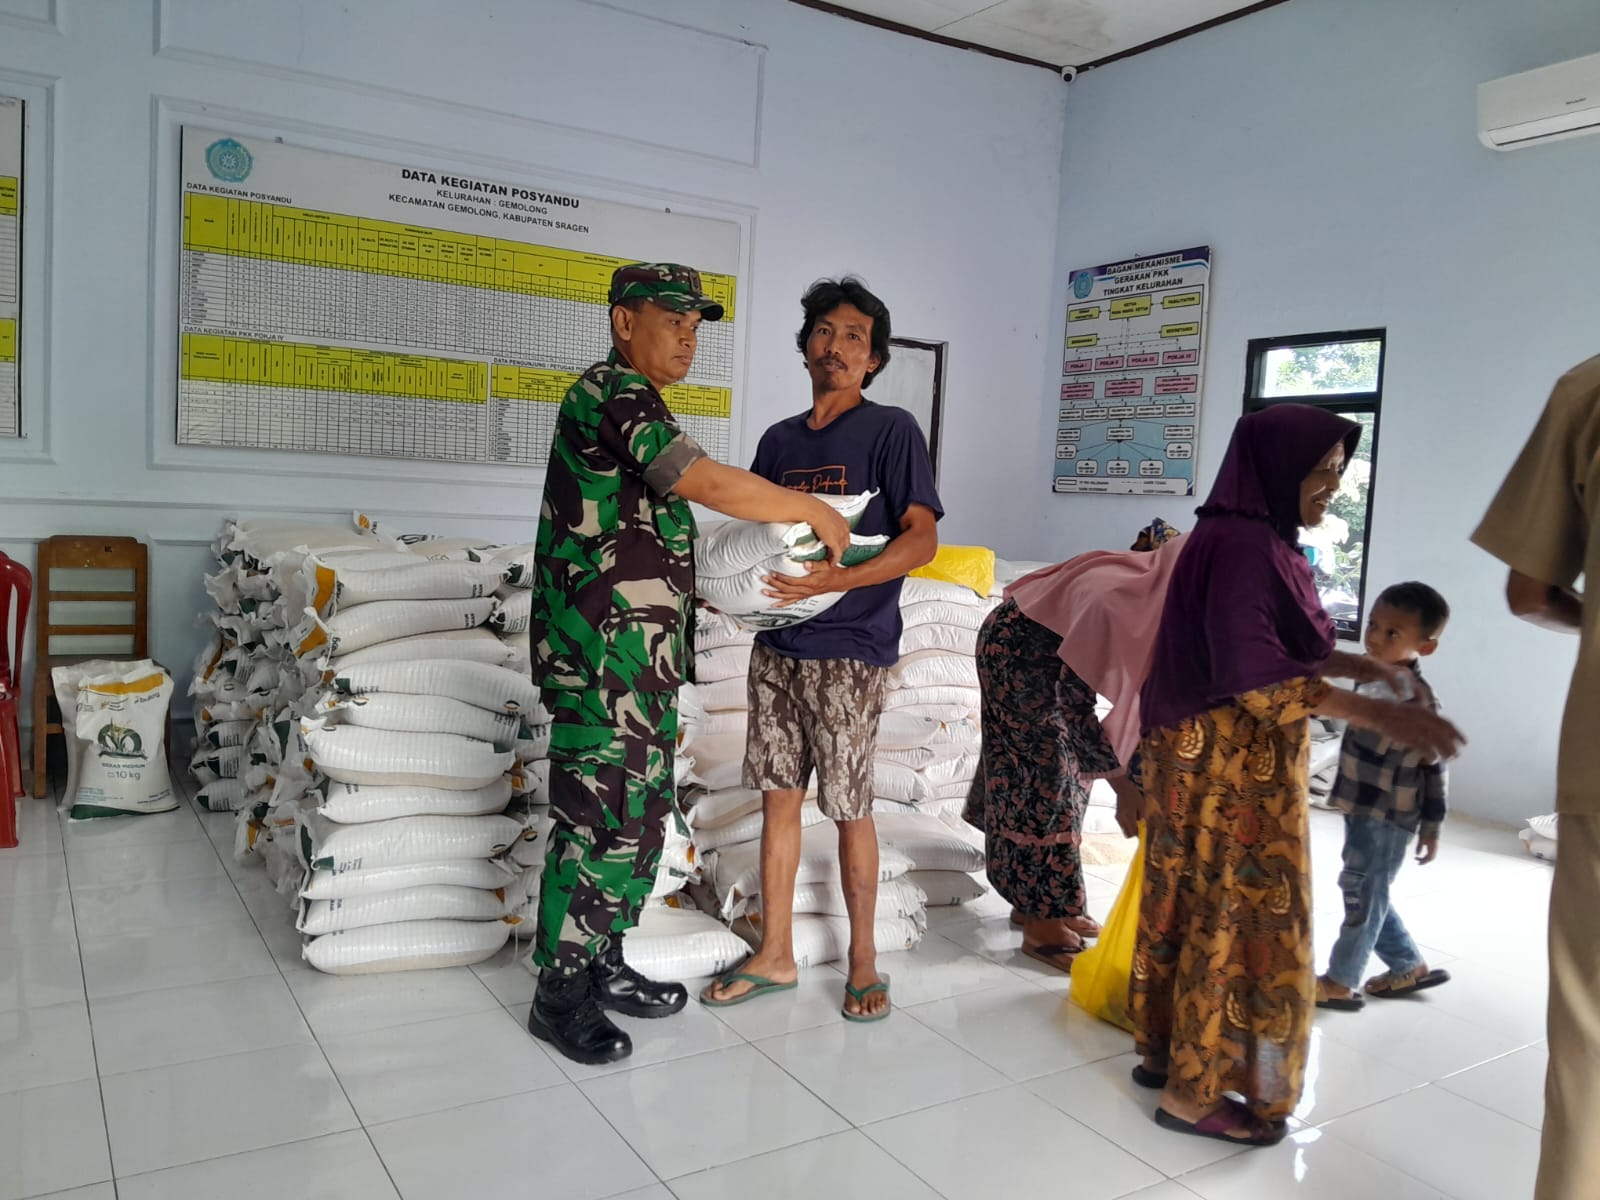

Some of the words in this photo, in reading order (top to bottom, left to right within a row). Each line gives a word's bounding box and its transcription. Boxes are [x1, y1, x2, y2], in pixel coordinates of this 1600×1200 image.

[186, 182, 207, 191] DATA
[209, 186, 248, 197] KEGIATAN
[250, 192, 292, 204] POSYANDU
[402, 169, 437, 184] DATA
[441, 175, 508, 196] KEGIATAN
[511, 188, 580, 209] POSYANDU
[436, 189, 491, 206] KELURAHAN
[498, 200, 548, 215] GEMOLONG
[389, 194, 445, 210] KECAMATAN
[447, 203, 501, 220] GEMOLONG,
[503, 212, 553, 228] KABUPATEN
[555, 221, 589, 233] SRAGEN
[1107, 264, 1132, 275] BAGAN
[1134, 256, 1182, 269] MEKANISME
[1114, 273, 1151, 284] GERAKAN
[1152, 269, 1169, 279] PKK
[1103, 285, 1134, 296] TINGKAT
[1136, 278, 1183, 291] KELURAHAN
[184, 325, 203, 333] DATA
[203, 327, 237, 336] KEGIATAN
[550, 363, 575, 371] PETUGAS
